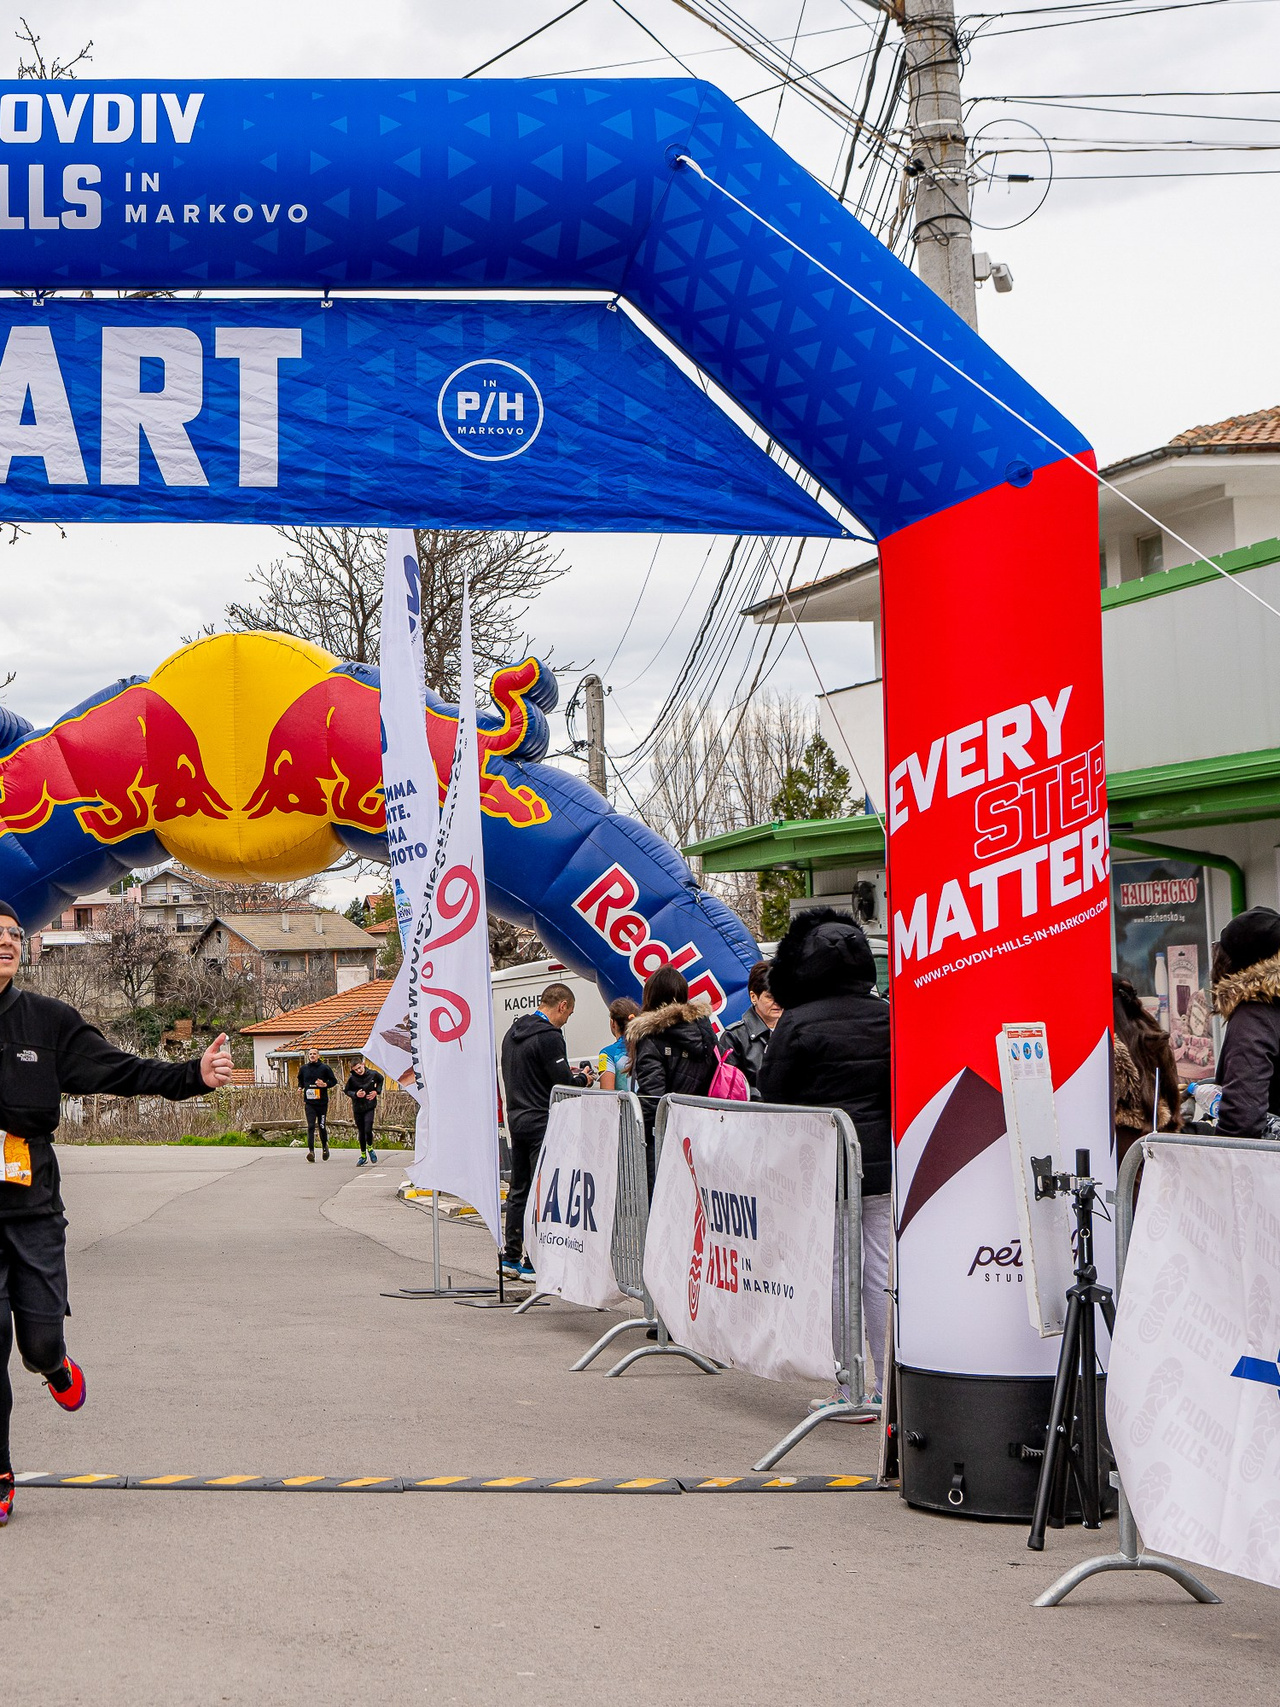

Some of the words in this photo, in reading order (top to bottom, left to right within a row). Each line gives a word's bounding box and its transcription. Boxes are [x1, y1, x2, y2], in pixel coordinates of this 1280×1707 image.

[124, 172, 160, 193] IN
[124, 204, 308, 224] MARKOVO
[482, 379, 497, 388] IN
[457, 391, 524, 424] P/H
[457, 426, 525, 436] MARKOVO
[889, 685, 1073, 837] EVERY
[973, 740, 1106, 860] STEP
[1120, 878, 1198, 907] НАШЕНСКО
[913, 896, 1109, 989] WWW.PLOVDIV-HILLS-IN-MARKOVO.COM
[741, 1257, 752, 1272] IN
[743, 1278, 795, 1300] MARKOVO
